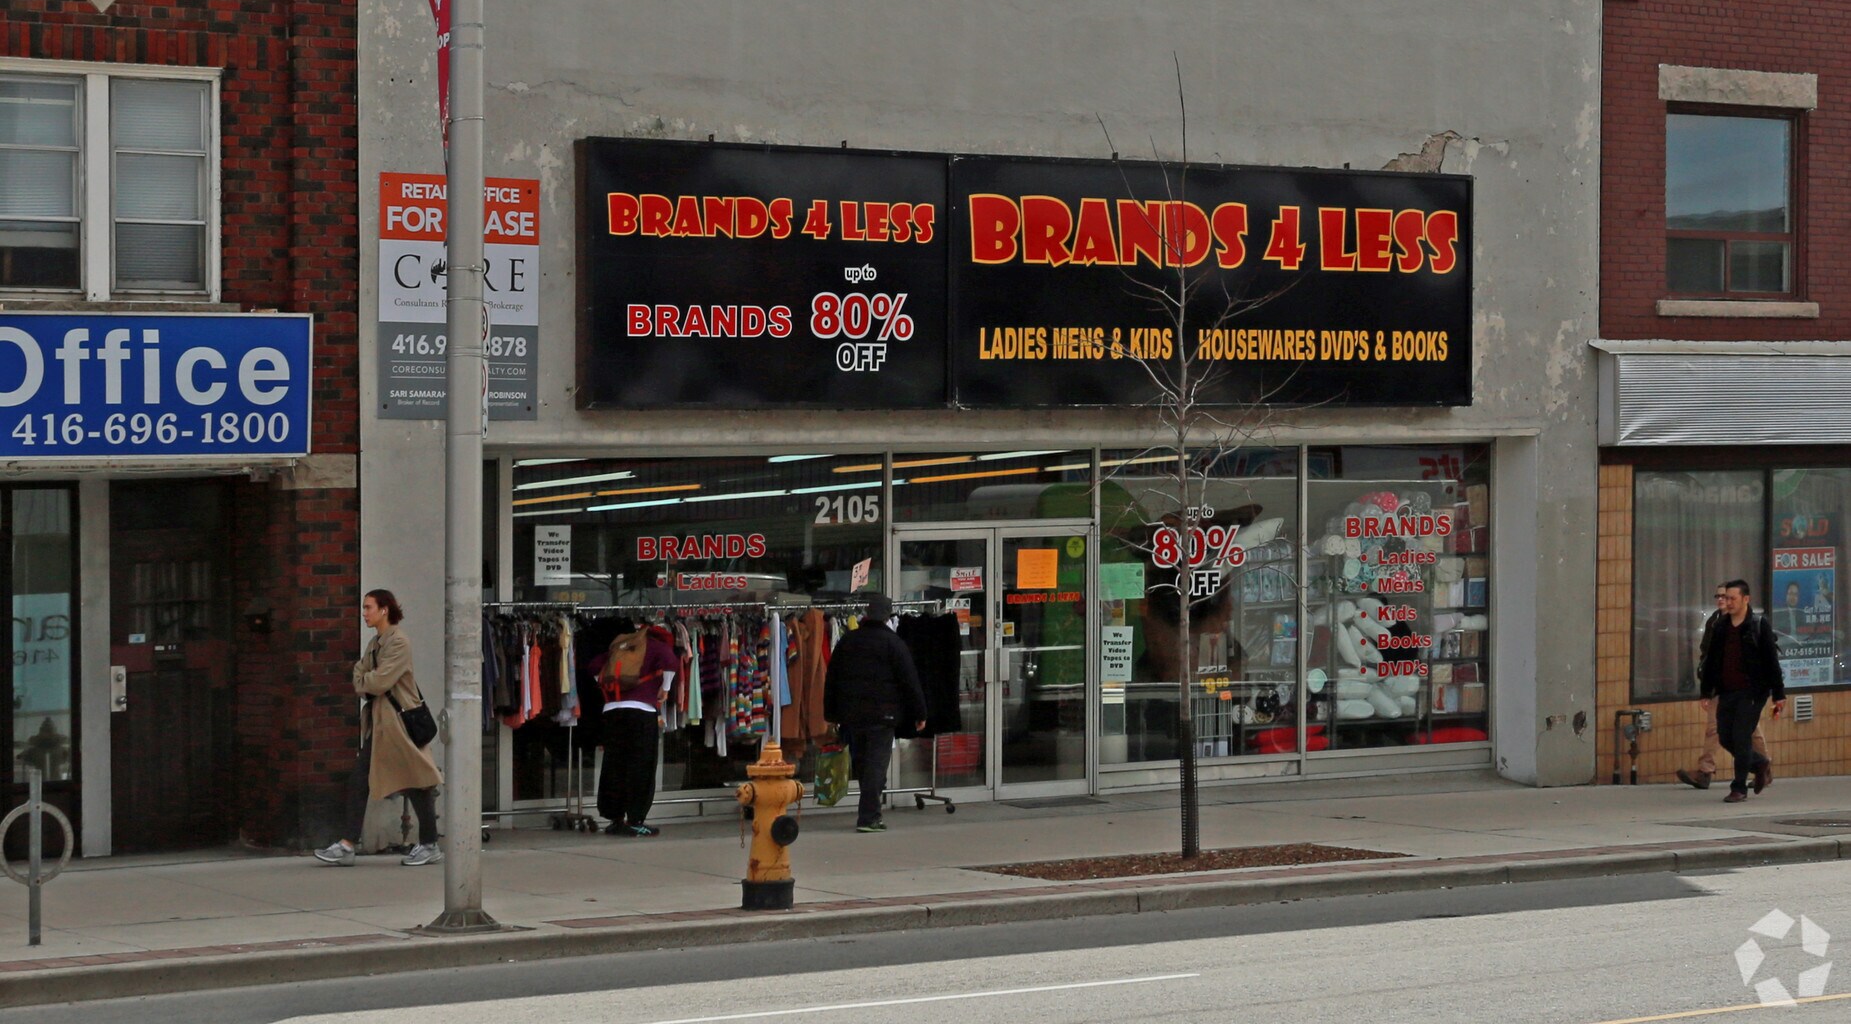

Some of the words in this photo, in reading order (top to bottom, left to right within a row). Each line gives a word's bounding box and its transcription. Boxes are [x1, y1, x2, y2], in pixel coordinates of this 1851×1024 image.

[387, 205, 443, 233] FOR
[484, 210, 535, 236] ASE
[607, 192, 793, 239] BRANDS
[801, 199, 832, 240] 4
[839, 200, 935, 244] LESS
[968, 193, 1248, 269] BRANDS
[1263, 205, 1306, 270] 4
[1318, 207, 1458, 274] LESS
[845, 266, 861, 283] up
[861, 264, 877, 280] to
[394, 298, 439, 308] Consultants
[627, 304, 793, 337] BRANDS
[810, 292, 914, 341] 80%
[979, 327, 1047, 360] LADIES
[1052, 327, 1105, 360] MENS
[1110, 329, 1124, 360] &
[1129, 328, 1173, 360] KIDS
[1198, 329, 1316, 361] HOUSEWARES
[1320, 330, 1369, 362] DVD'S
[1374, 330, 1386, 361] &
[1391, 330, 1448, 362] BOOKS
[836, 342, 887, 372] OFF
[390, 390, 407, 398] SARI
[488, 391, 527, 399] ROBINSON
[11, 412, 290, 445] 416-696-1800
[814, 495, 880, 524] 2105
[1345, 515, 1452, 538] BRANDS
[637, 533, 766, 561] BRANDS
[1152, 525, 1246, 569] 80%
[1378, 549, 1436, 565] Ladies
[1775, 553, 1798, 568] FOR
[1802, 552, 1831, 567] SALE
[677, 573, 748, 591] Ladies
[1378, 578, 1424, 593] Mens
[1378, 605, 1417, 622] Kids
[1377, 633, 1433, 650] Books
[1377, 661, 1429, 677] DVD's
